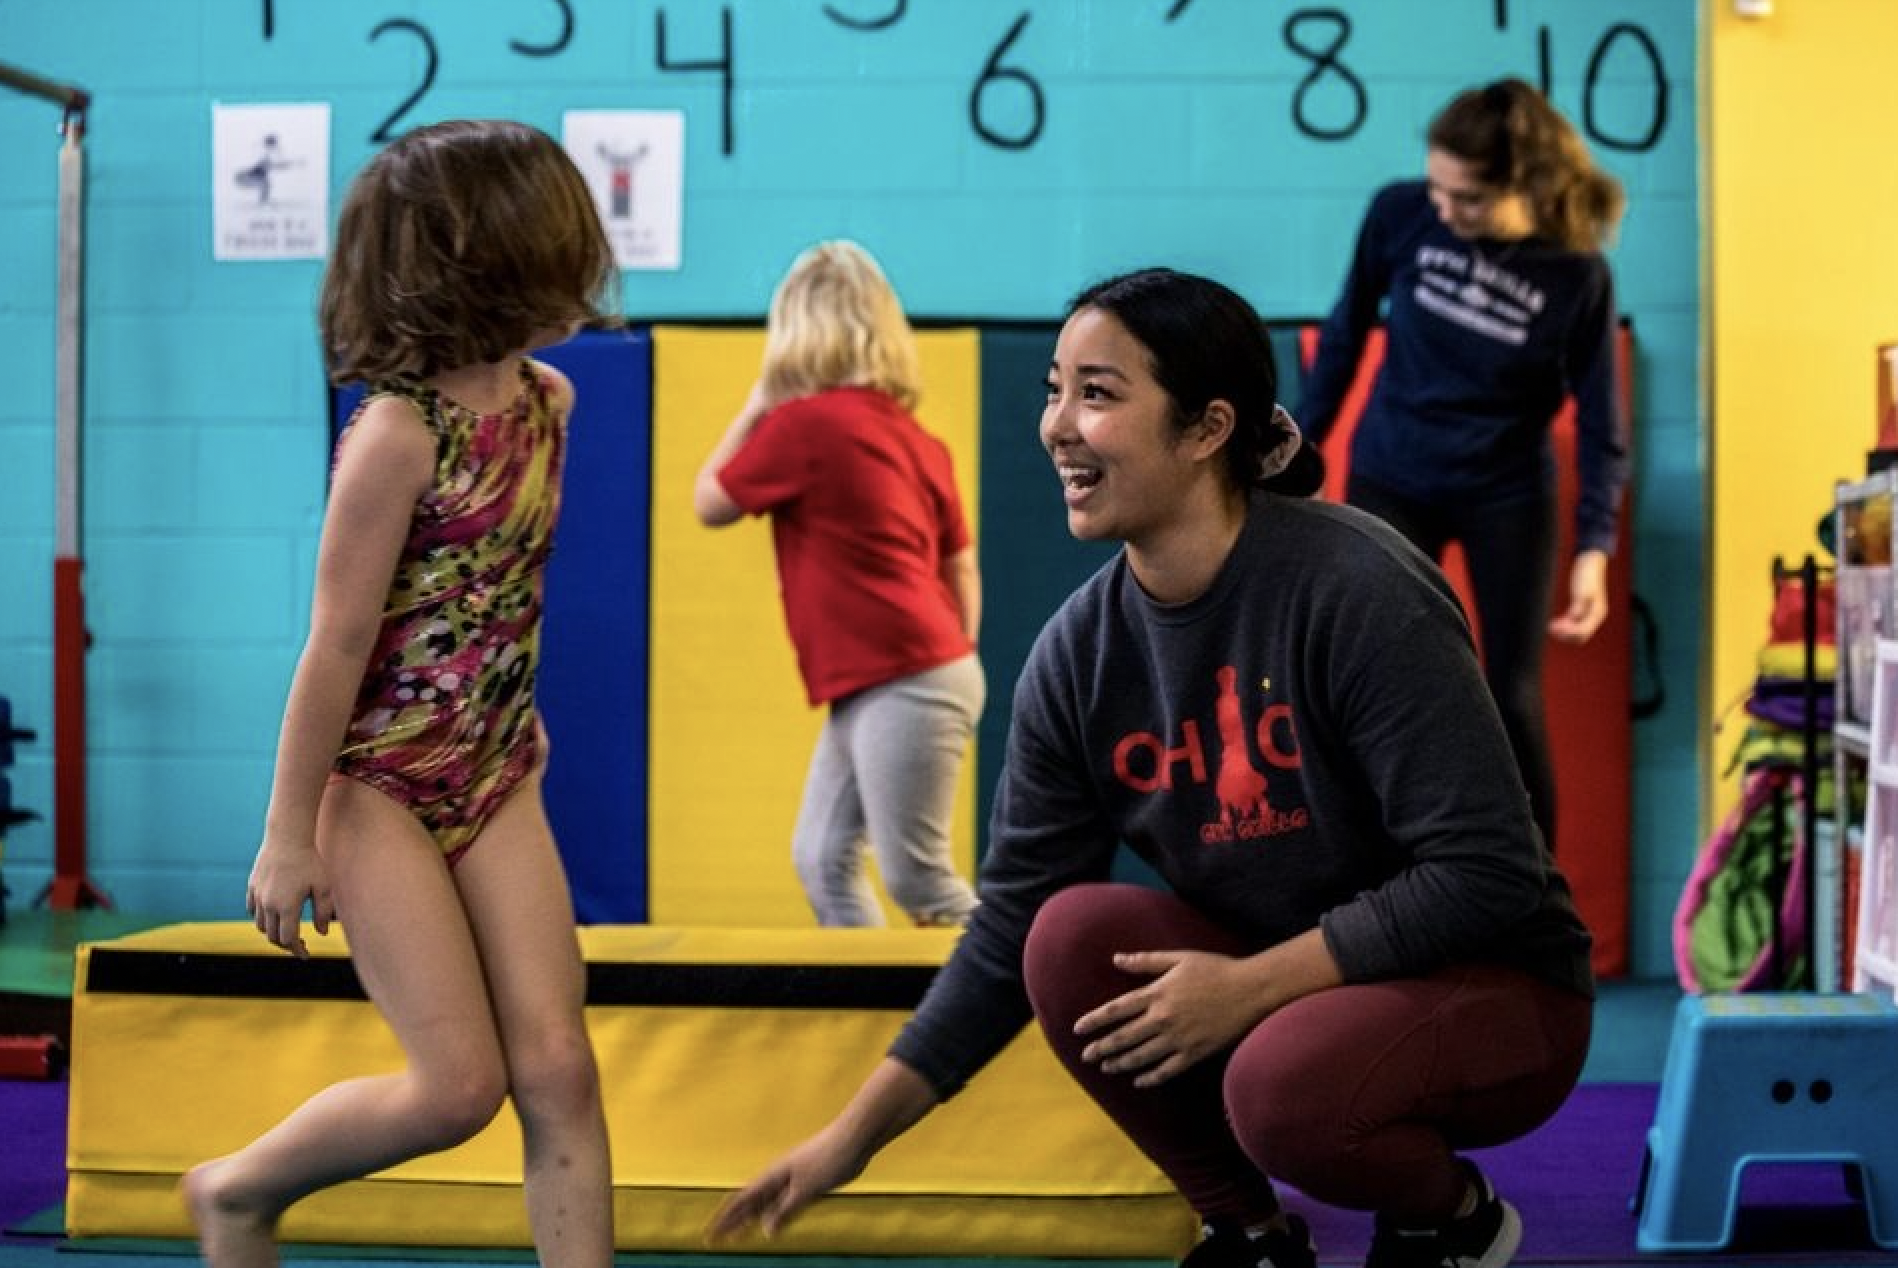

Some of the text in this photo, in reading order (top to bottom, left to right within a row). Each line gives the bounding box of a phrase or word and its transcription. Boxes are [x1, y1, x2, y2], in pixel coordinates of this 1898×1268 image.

[369, 18, 439, 143] 2
[656, 8, 734, 156] 4
[969, 11, 1046, 151] 6
[1283, 9, 1368, 142] 8
[1538, 22, 1670, 154] 10
